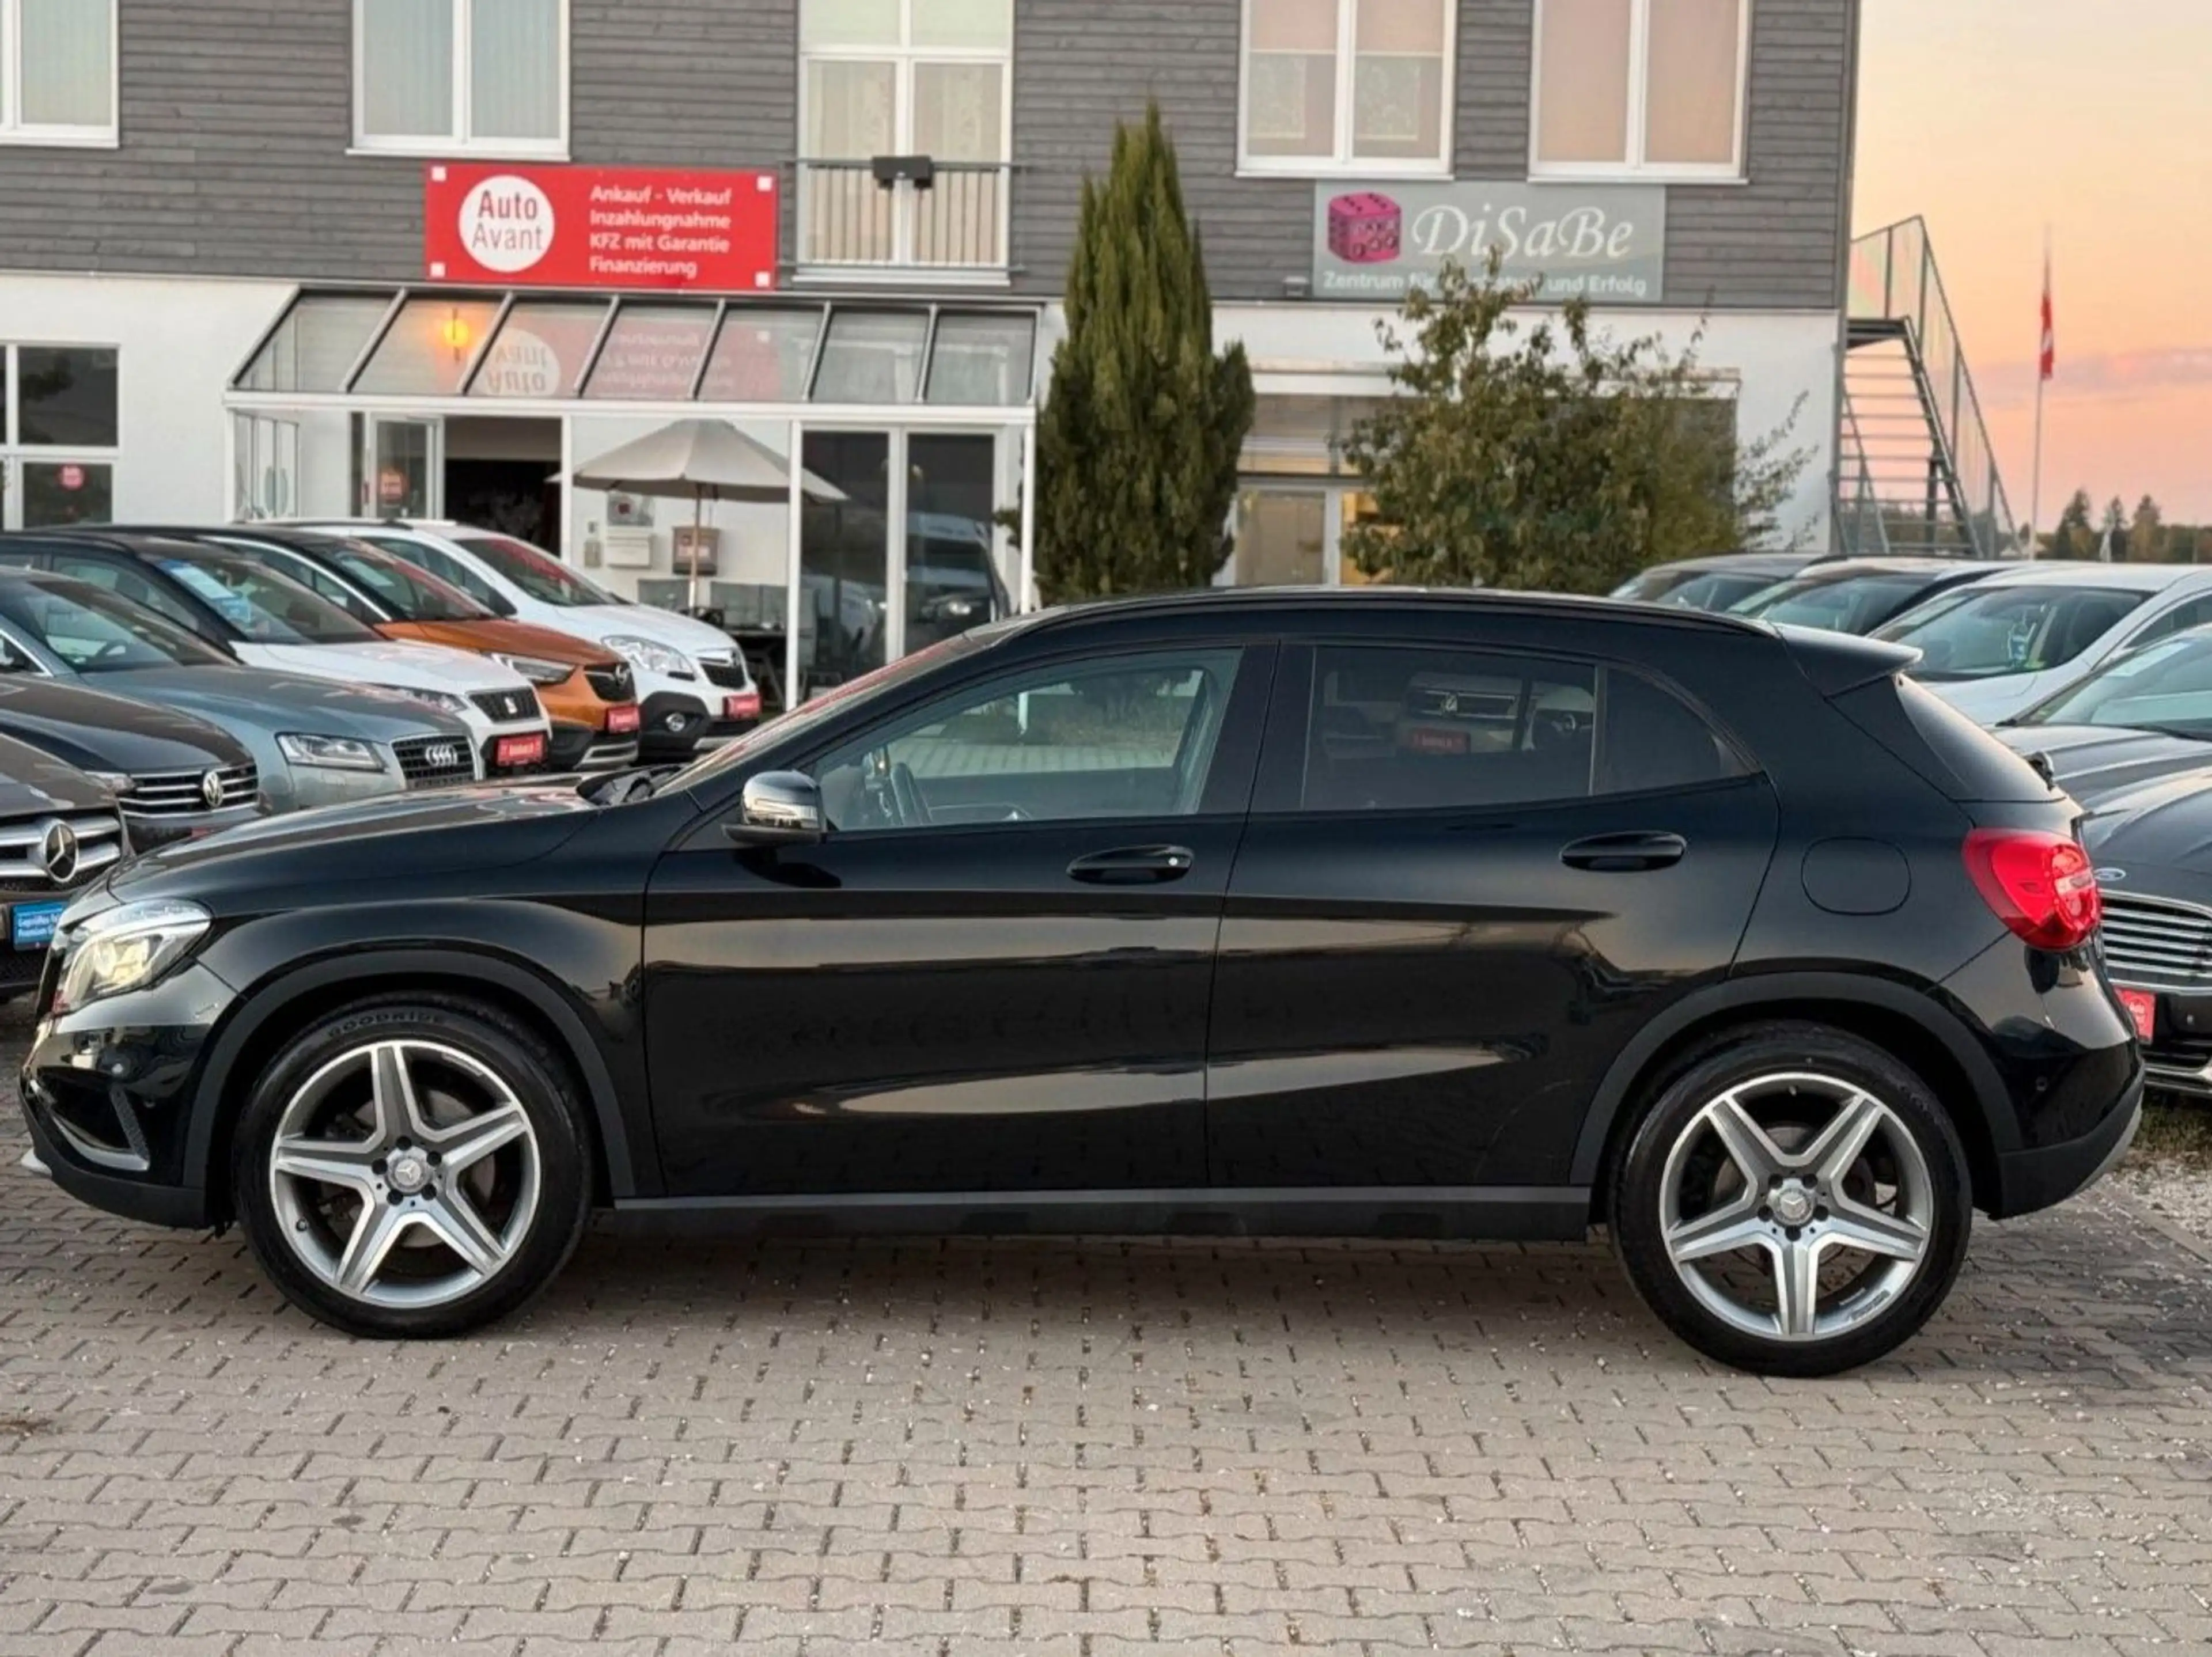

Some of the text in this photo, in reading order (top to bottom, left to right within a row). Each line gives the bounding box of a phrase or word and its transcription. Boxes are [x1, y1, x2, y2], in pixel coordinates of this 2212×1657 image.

[478, 189, 538, 220] Auto
[589, 184, 652, 204] Ankauf
[666, 187, 732, 205] Verkauf
[590, 209, 731, 232] Inzahlungnahme
[1411, 202, 1634, 259] DiSaBe
[472, 221, 543, 250] Avant
[589, 232, 730, 253] KFZ mit Garantie
[589, 255, 698, 280] Finanzierung
[1323, 270, 1404, 289] Zentrum
[1548, 274, 1584, 292] und
[1586, 275, 1647, 298] Erfolg
